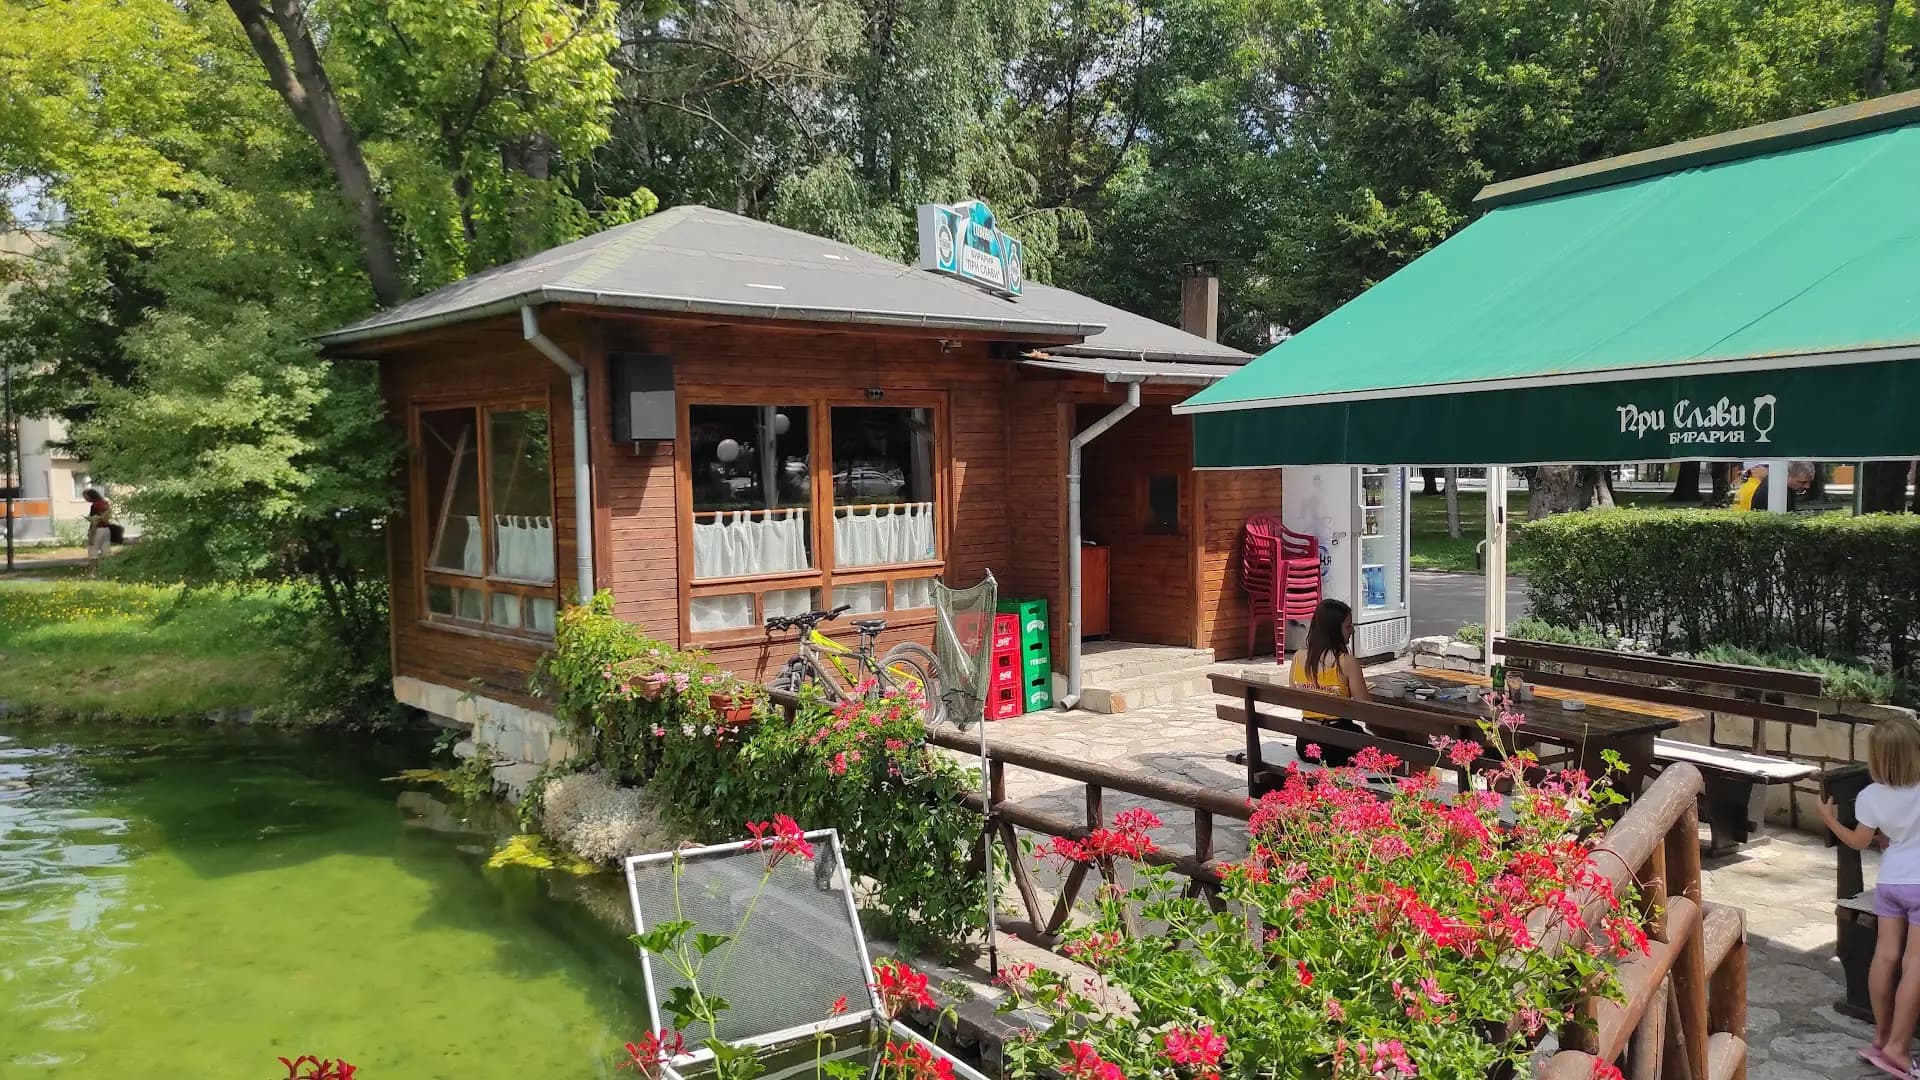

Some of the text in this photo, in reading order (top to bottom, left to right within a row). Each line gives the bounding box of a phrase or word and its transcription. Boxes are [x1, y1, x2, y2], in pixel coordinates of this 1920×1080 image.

[1616, 396, 1746, 439] При Слави
[1669, 430, 1746, 445] БИРАРИЯ
